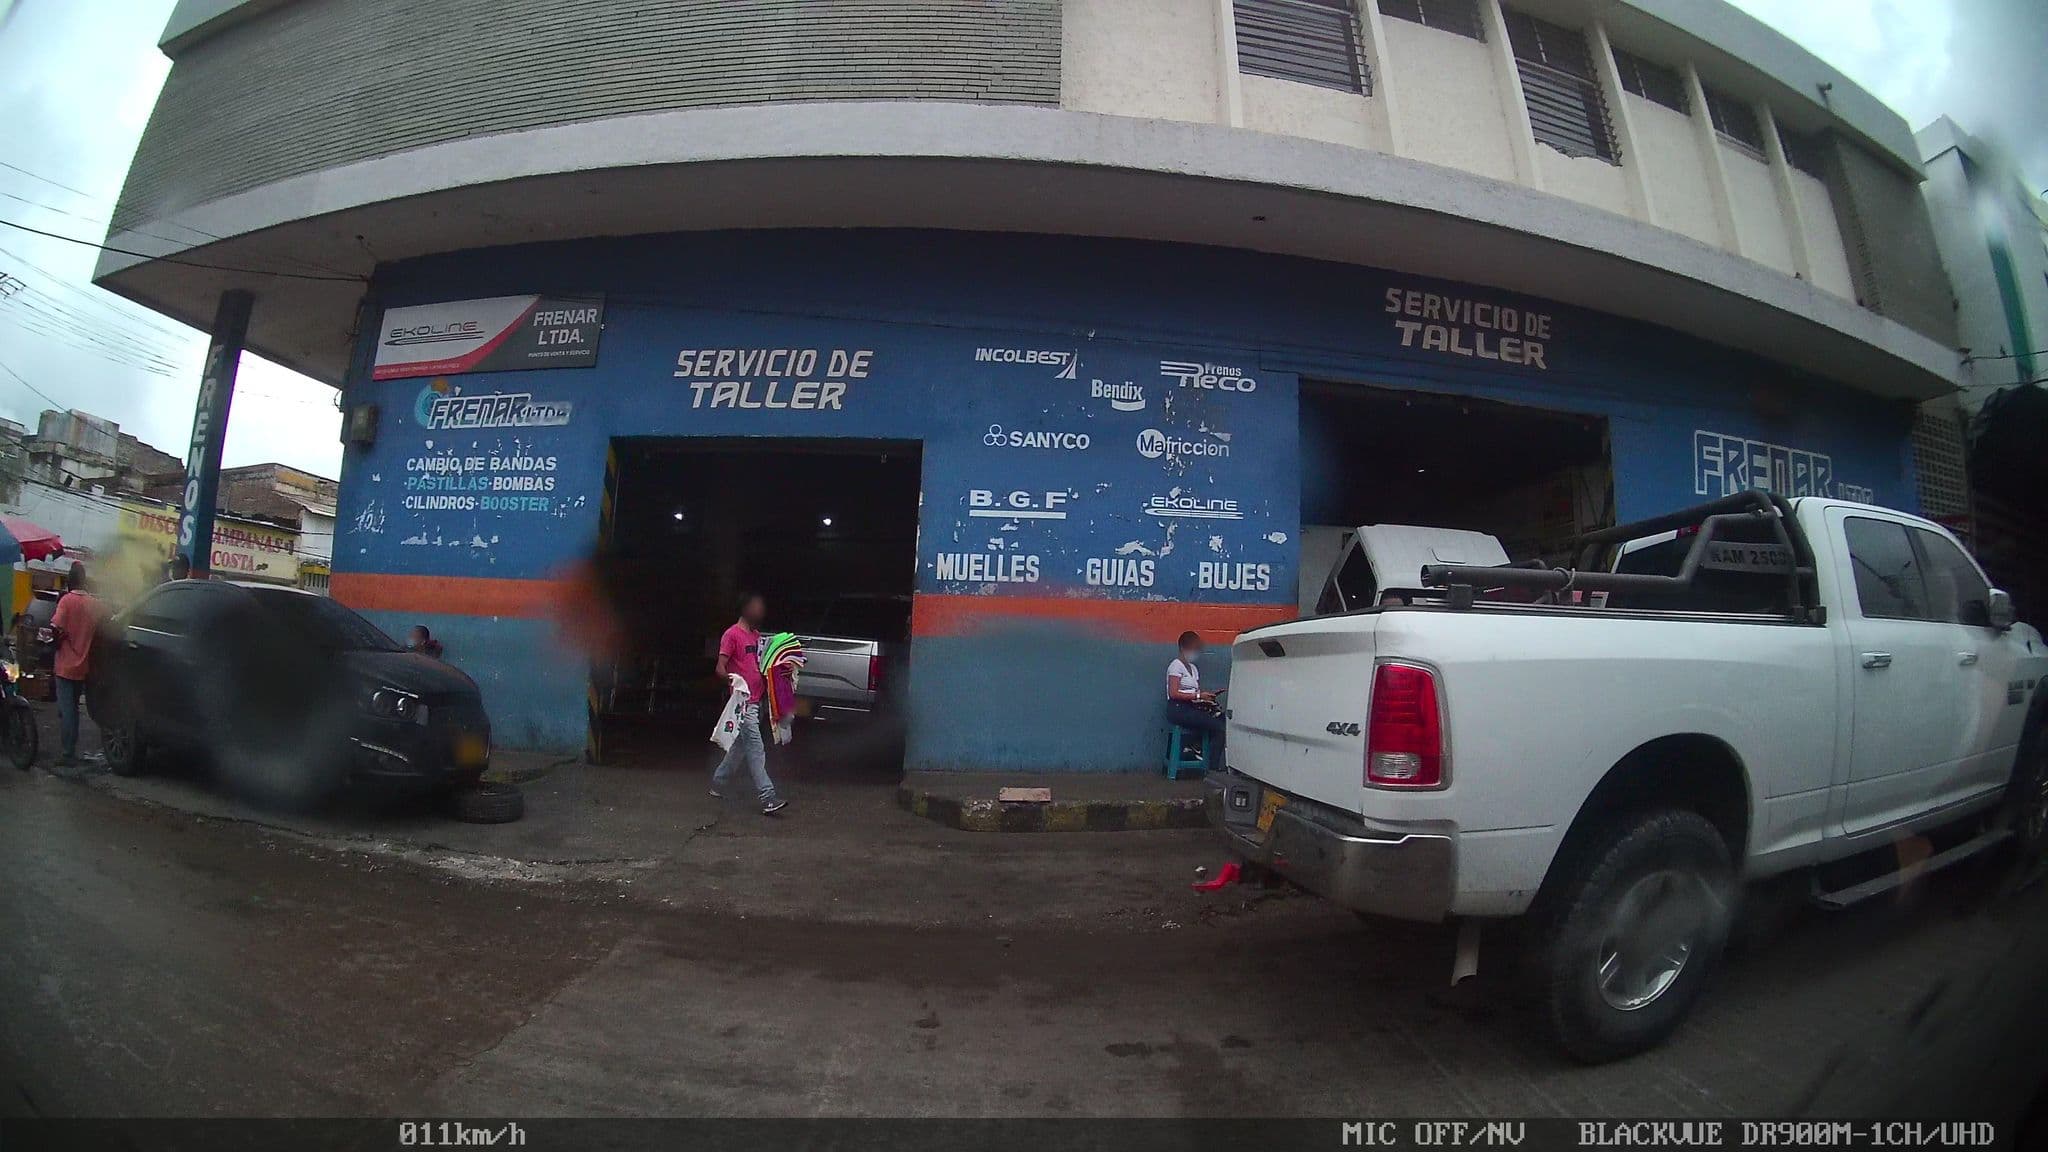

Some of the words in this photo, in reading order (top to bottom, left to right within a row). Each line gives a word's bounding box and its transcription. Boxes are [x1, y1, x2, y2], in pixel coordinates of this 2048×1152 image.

[533, 309, 598, 326] FRENAR
[1385, 287, 1518, 333] SERVICIO
[1524, 312, 1551, 339] DE
[390, 321, 478, 338] EKOLINE
[538, 328, 584, 345] LTDA.
[975, 347, 1070, 365] INCOLBEST
[1395, 320, 1547, 370] TALLER
[673, 350, 817, 377] SERVICIO
[827, 350, 874, 378] DE
[1205, 362, 1242, 377] Frenos
[689, 382, 847, 409] TALLER
[1091, 379, 1143, 400] Bendix
[427, 393, 532, 429] FRENAR
[180, 344, 225, 547] FRENOS
[1009, 430, 1090, 450] SANYCO
[1139, 433, 1230, 457] Mafriccion
[406, 457, 460, 472] CAMBIO
[464, 457, 484, 471] DE
[489, 456, 557, 471] BANDAS
[1694, 430, 1833, 498] FRENAR
[407, 476, 488, 491] PASTILLAS
[493, 476, 555, 491] BOMBAS
[405, 496, 476, 511] CILINDROS
[480, 496, 549, 512] BOOSTER
[1150, 496, 1239, 511] EKOLINE
[212, 550, 254, 572] COSTA
[937, 553, 1040, 583] MUELLES
[1085, 558, 1155, 587] GUIAS
[1198, 562, 1270, 591] BUJES
